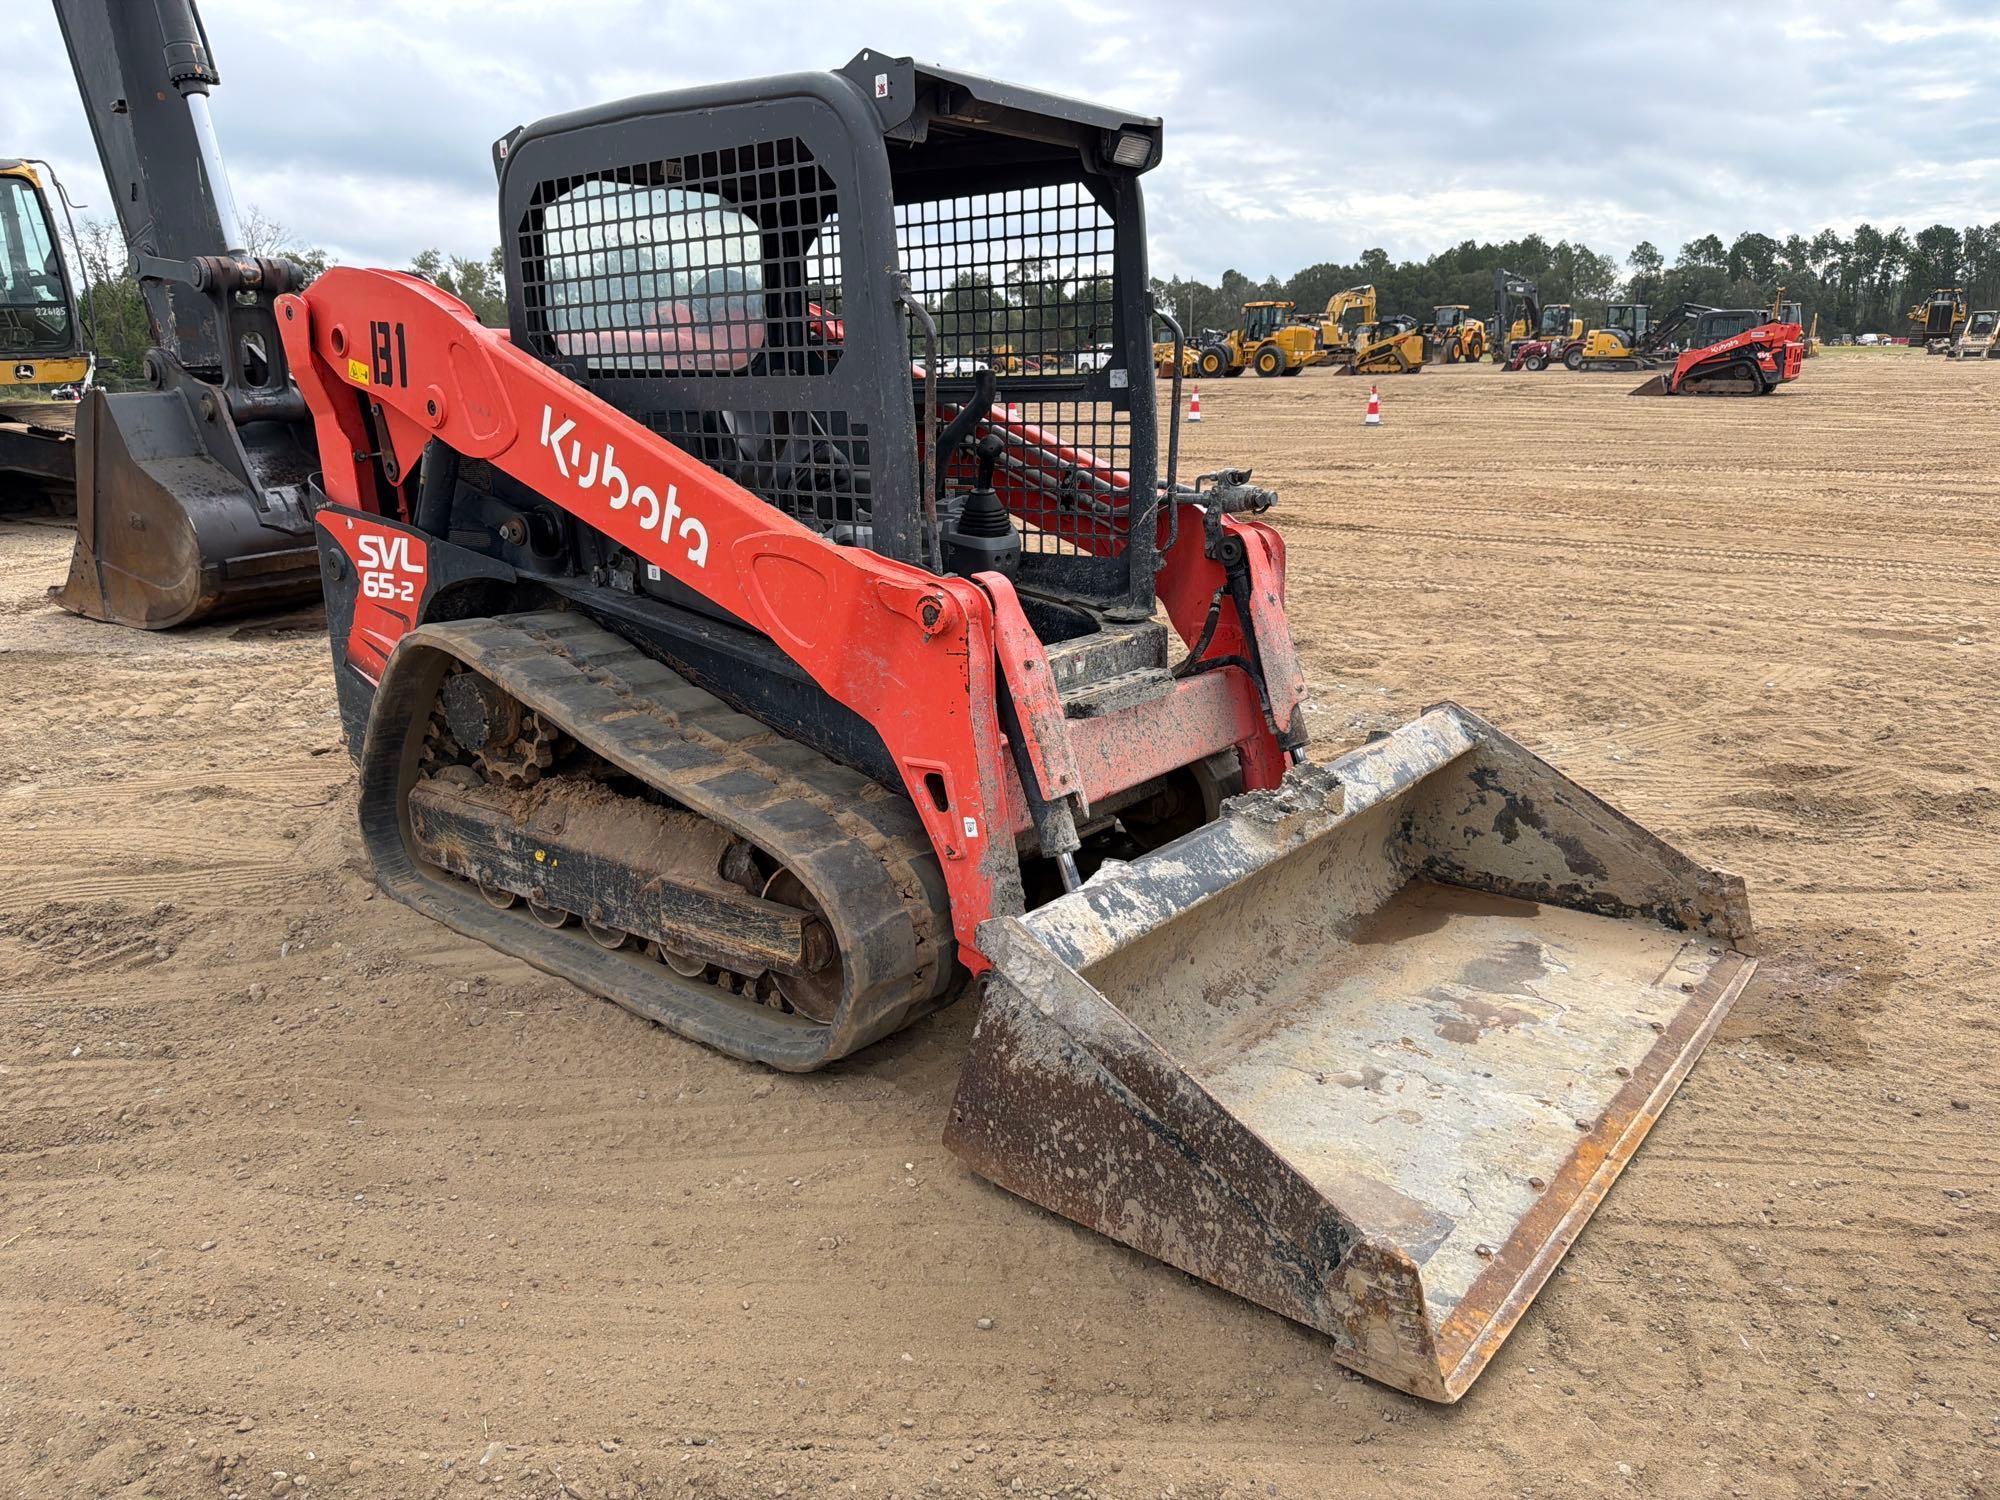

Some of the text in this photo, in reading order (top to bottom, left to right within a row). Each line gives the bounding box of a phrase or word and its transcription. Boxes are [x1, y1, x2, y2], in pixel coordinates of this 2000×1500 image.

[540, 404, 709, 569] Kubota
[358, 534, 424, 574] SVL
[363, 571, 414, 602] 65-2
